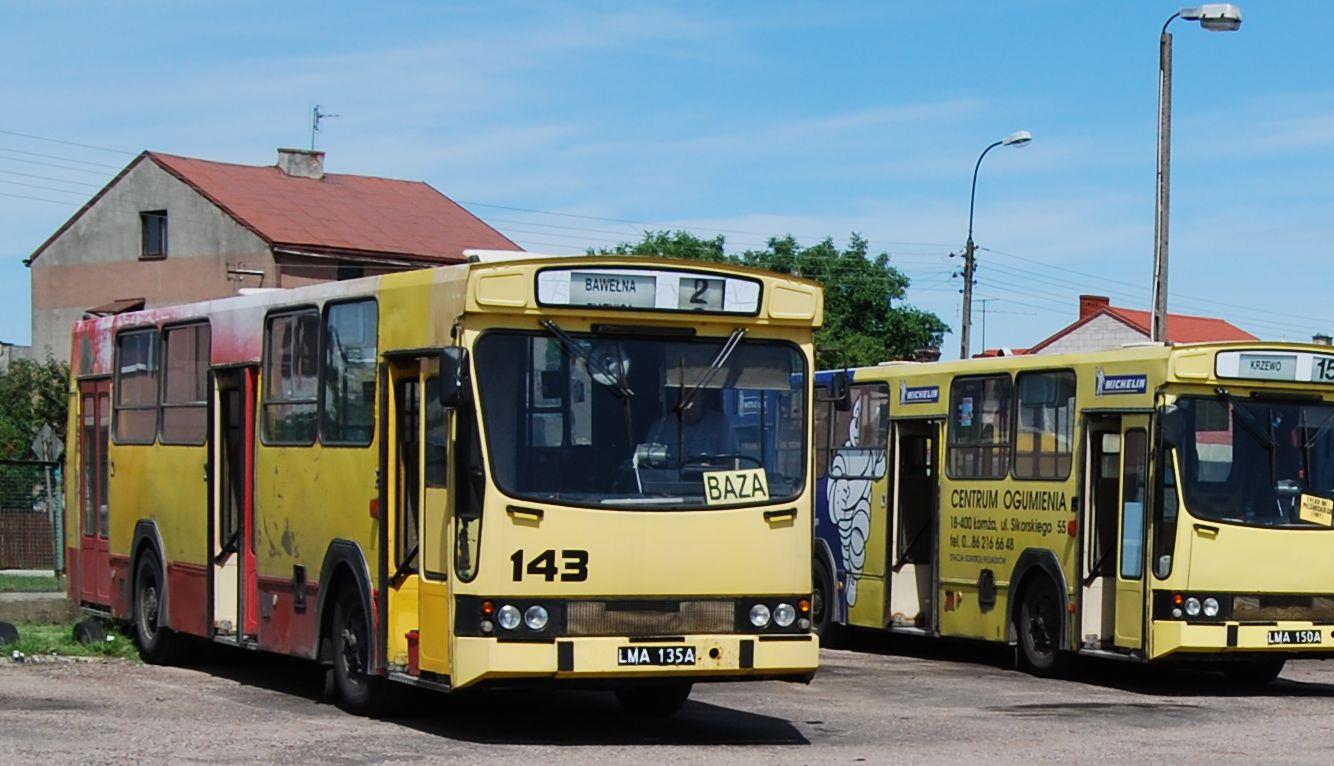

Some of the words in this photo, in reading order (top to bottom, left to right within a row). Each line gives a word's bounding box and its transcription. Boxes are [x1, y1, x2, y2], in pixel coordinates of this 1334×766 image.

[585, 278, 636, 292] BAWEŁNA
[690, 279, 708, 304] 2
[1250, 360, 1281, 372] KRZEWO
[1104, 376, 1145, 389] MICHELIN
[906, 389, 938, 400] MICHELIN
[707, 473, 766, 500] BAZA
[951, 489, 998, 508] CENTRUM
[1003, 490, 1067, 511] OGUMIENIA
[1011, 518, 1052, 536] Sikorskiego
[1057, 520, 1066, 534] 55
[981, 535, 994, 549] 216
[995, 537, 1004, 550] 66
[1005, 537, 1015, 551] 48
[510, 549, 589, 582] 143
[1268, 631, 1290, 643] LMA
[1295, 630, 1321, 643] 150A
[618, 647, 650, 664] LMA
[658, 647, 695, 664] 135A
